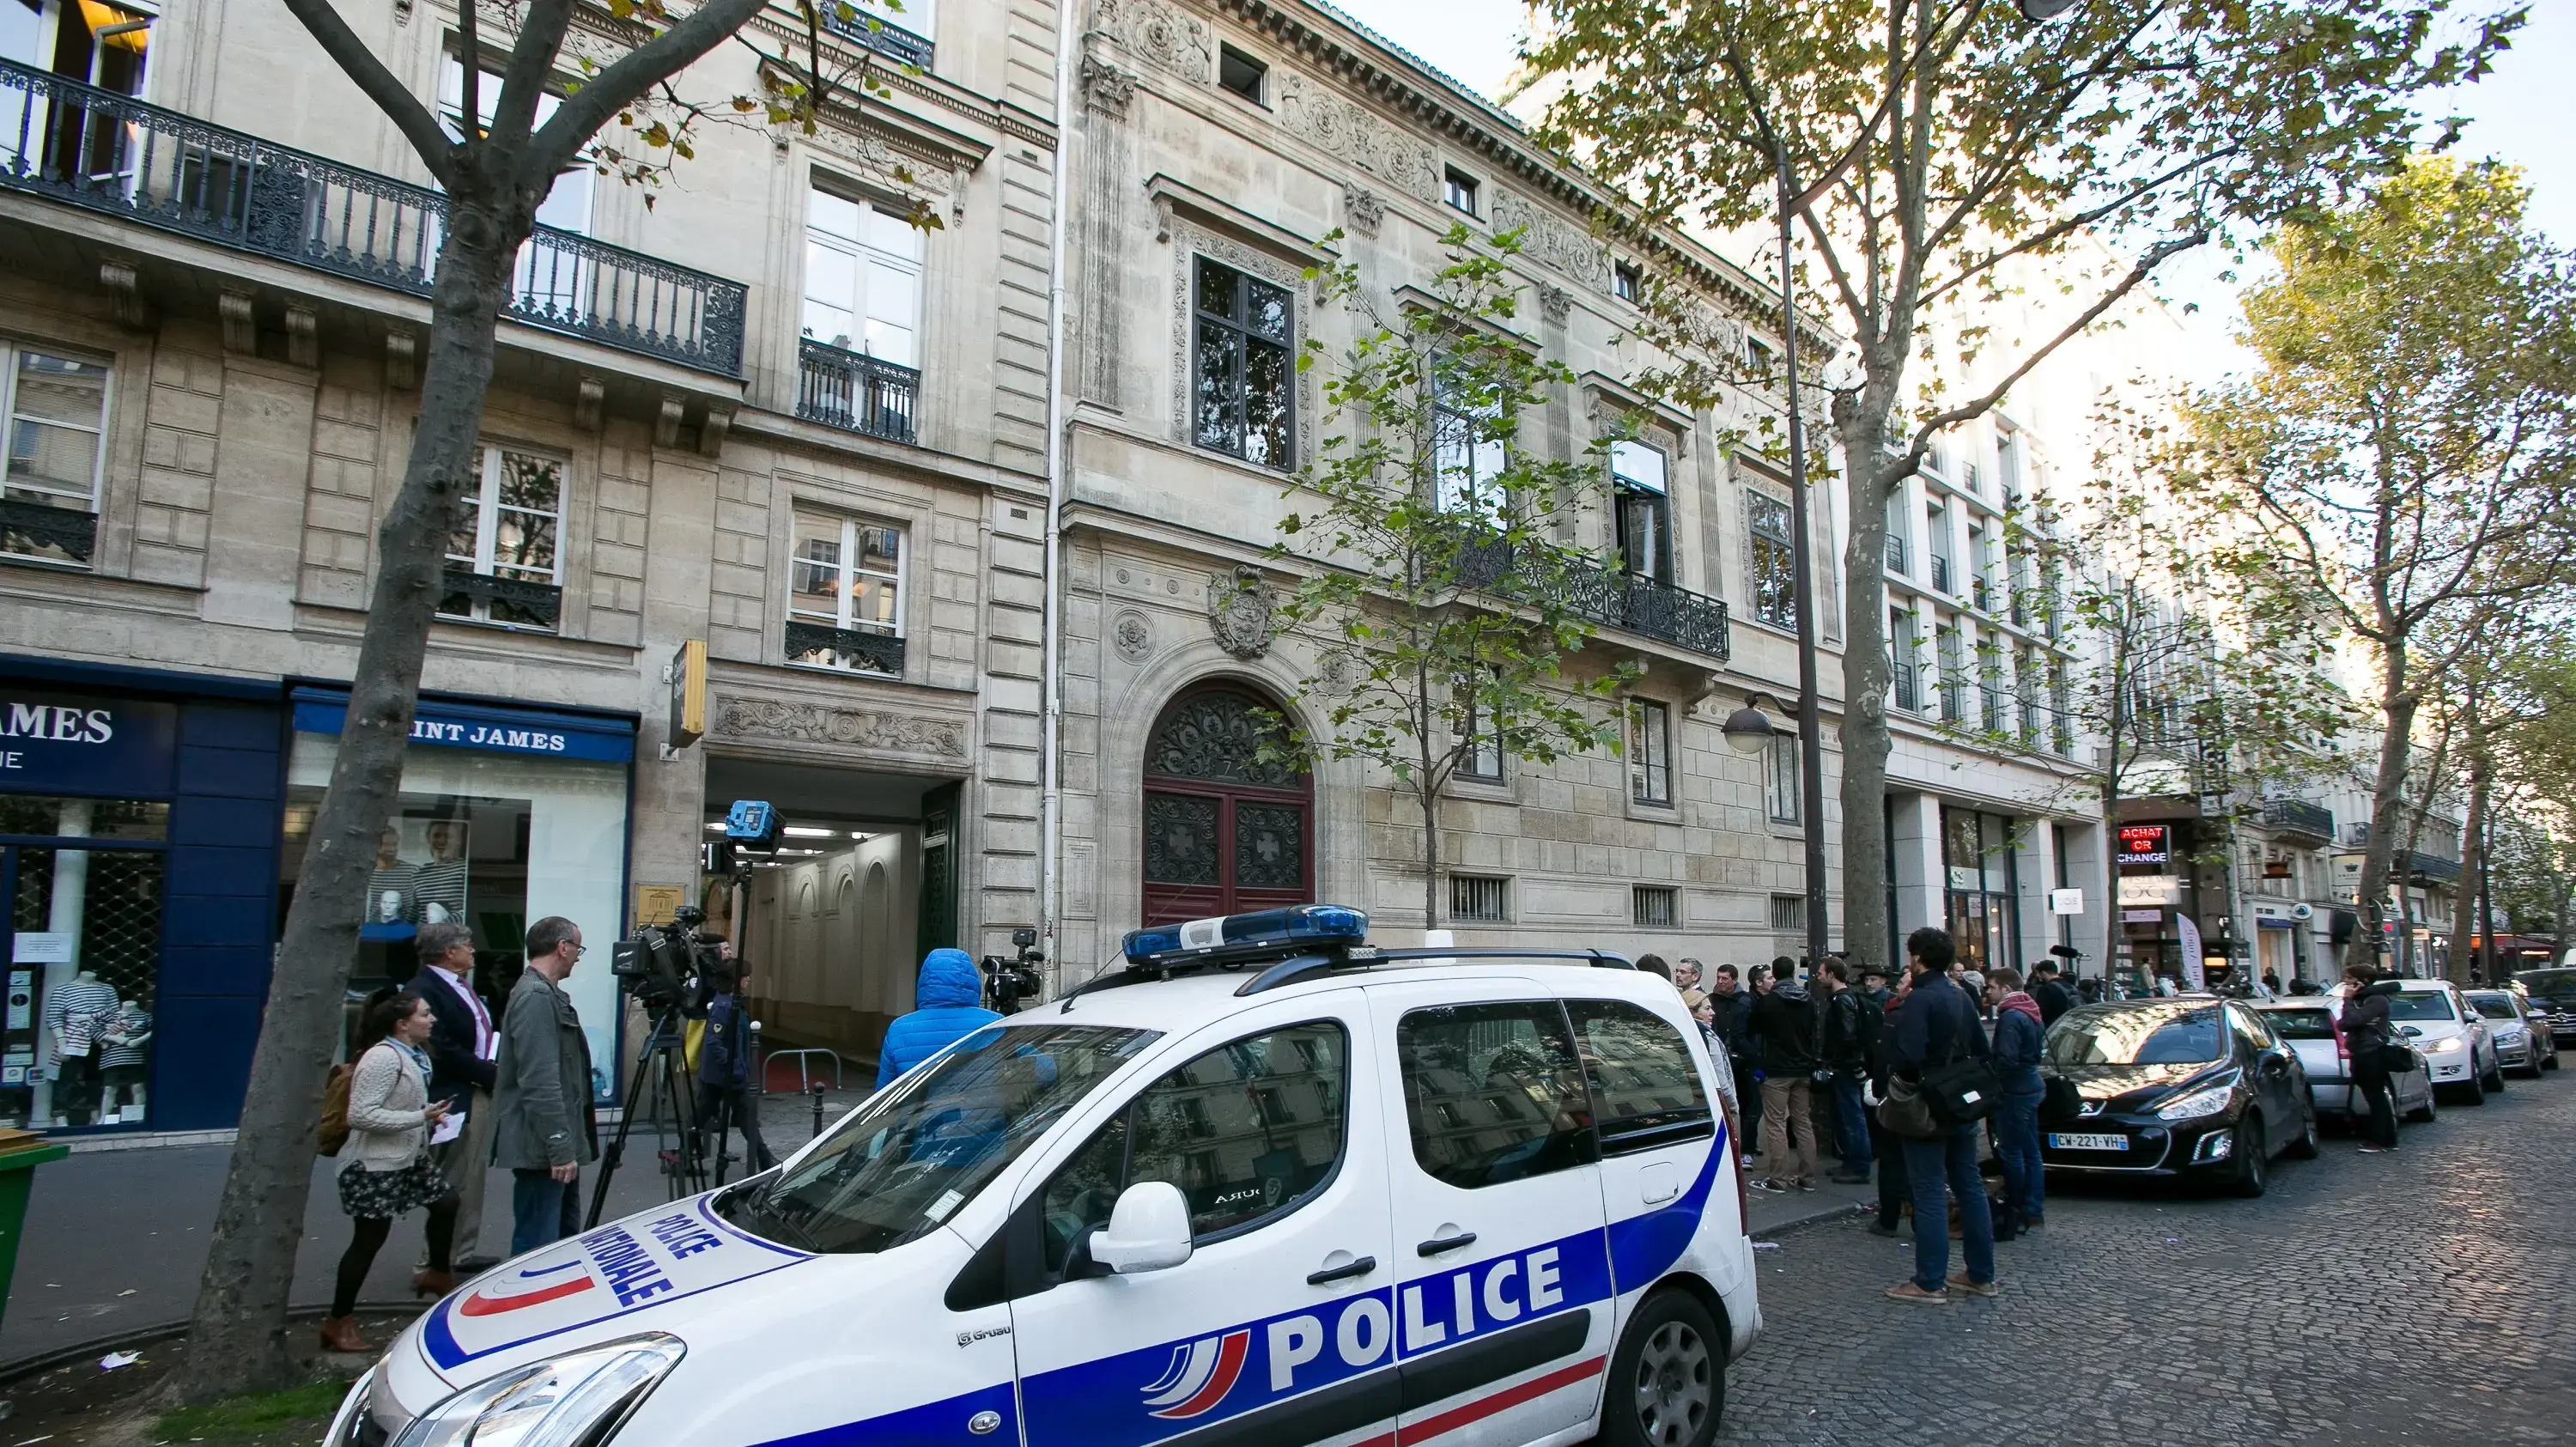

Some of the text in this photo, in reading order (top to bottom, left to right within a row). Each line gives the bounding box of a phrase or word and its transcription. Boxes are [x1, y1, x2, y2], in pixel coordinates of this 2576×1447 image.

[0, 702, 112, 744] MES
[408, 720, 566, 751] INT JAMES
[0, 751, 23, 769] E
[2123, 827, 2163, 838] ACHAT
[2134, 840, 2153, 850] OR
[2117, 852, 2167, 863] CHANGE
[2058, 1134, 2118, 1148] CW-221-VH
[643, 1213, 724, 1260] POLICE
[578, 1225, 674, 1308] NATIONALE
[1267, 1246, 1564, 1392] POLICE
[973, 1325, 1012, 1341] Gruau
